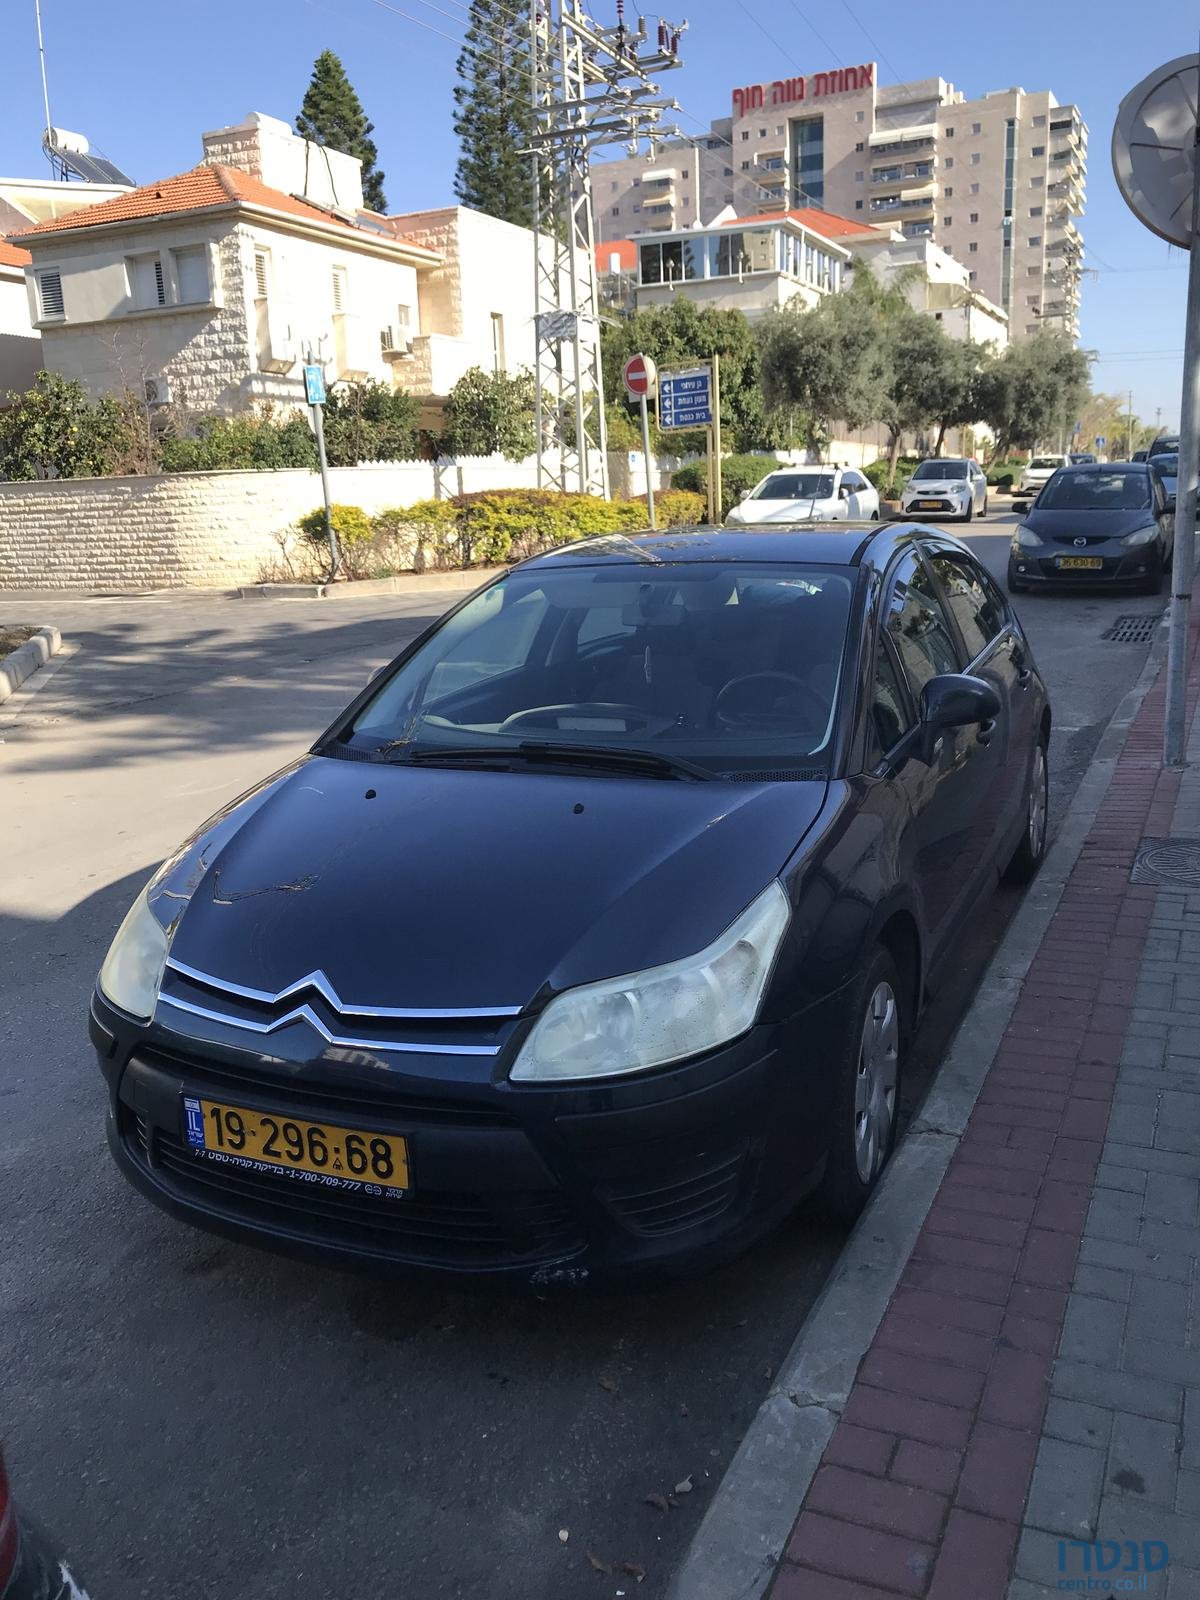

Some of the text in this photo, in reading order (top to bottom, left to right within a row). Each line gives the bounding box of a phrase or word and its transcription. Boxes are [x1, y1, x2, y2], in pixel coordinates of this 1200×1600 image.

[814, 63, 874, 97] אחוזת
[732, 84, 764, 118] חוף
[695, 412, 706, 420] בית
[188, 1111, 201, 1131] IL
[253, 1162, 284, 1175] בדיקת
